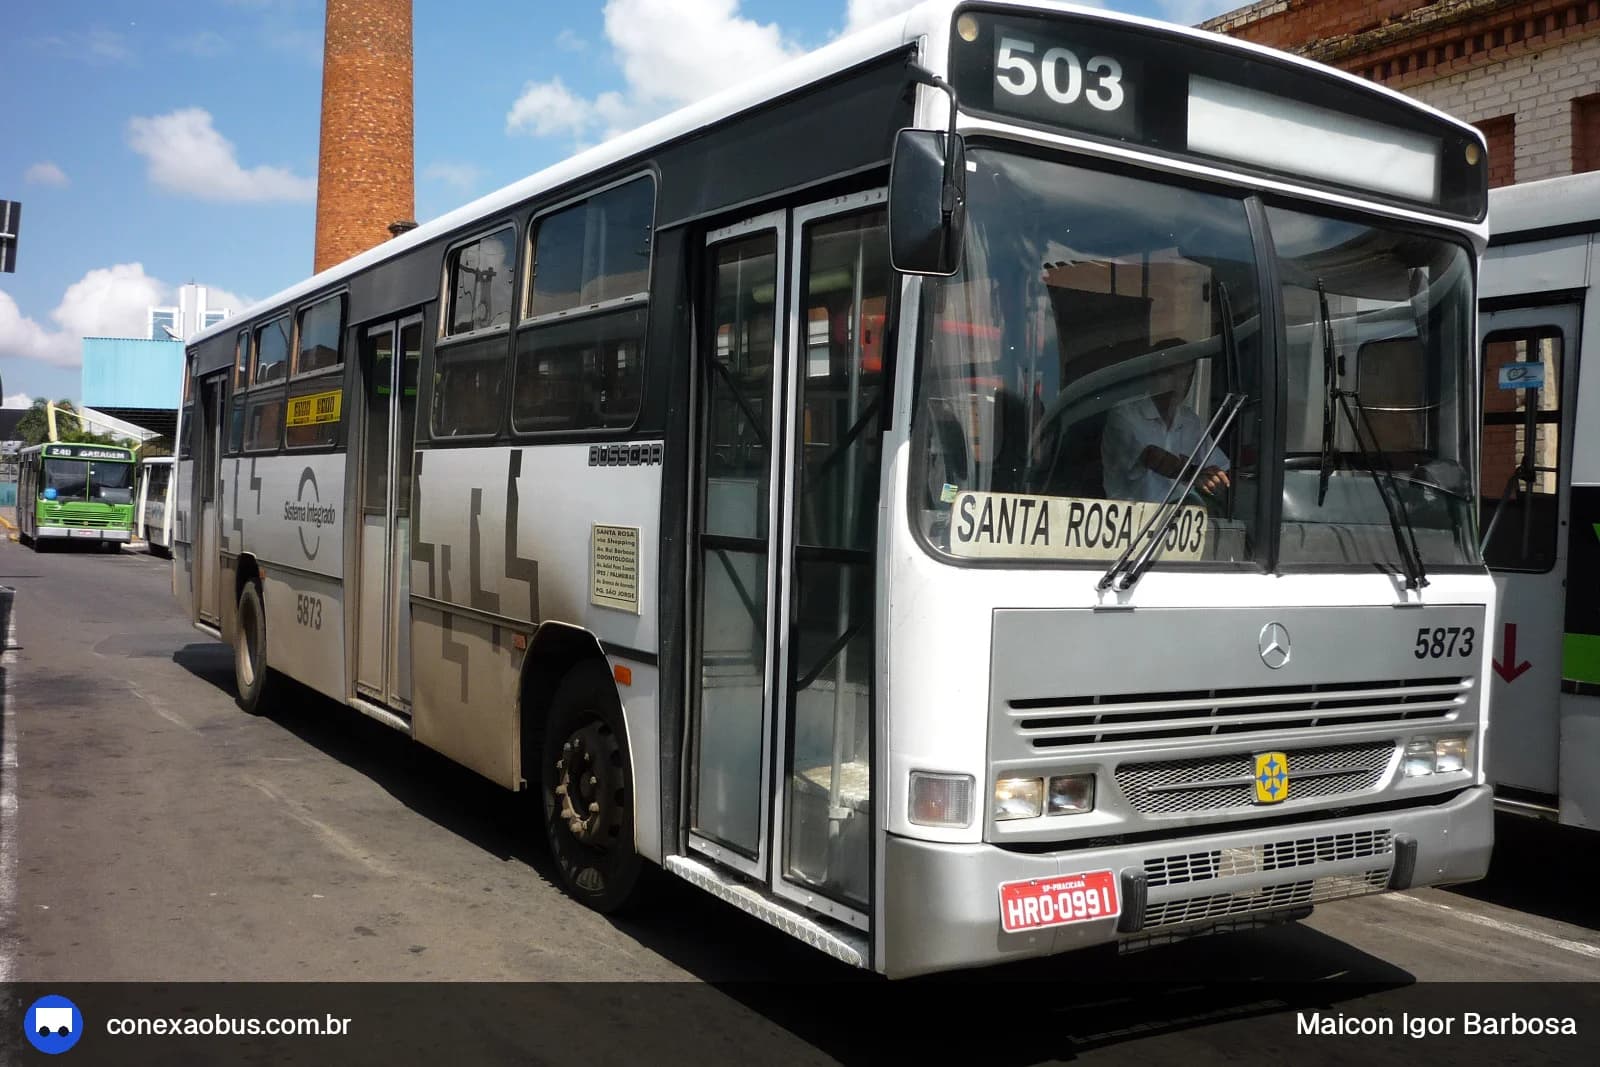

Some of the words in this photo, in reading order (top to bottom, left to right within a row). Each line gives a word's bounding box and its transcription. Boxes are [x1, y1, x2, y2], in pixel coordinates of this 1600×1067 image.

[996, 37, 1125, 111] 503
[284, 501, 306, 521] Sistema
[307, 502, 335, 528] Integrado
[957, 494, 1050, 545] SANTA
[1065, 502, 1135, 549] ROSA
[1164, 509, 1204, 553] 503
[596, 528, 616, 536] SANTA
[607, 538, 635, 547] Shopping
[296, 594, 322, 630] 5873
[1414, 627, 1475, 659] 5873
[1007, 886, 1111, 927] HRO-0991
